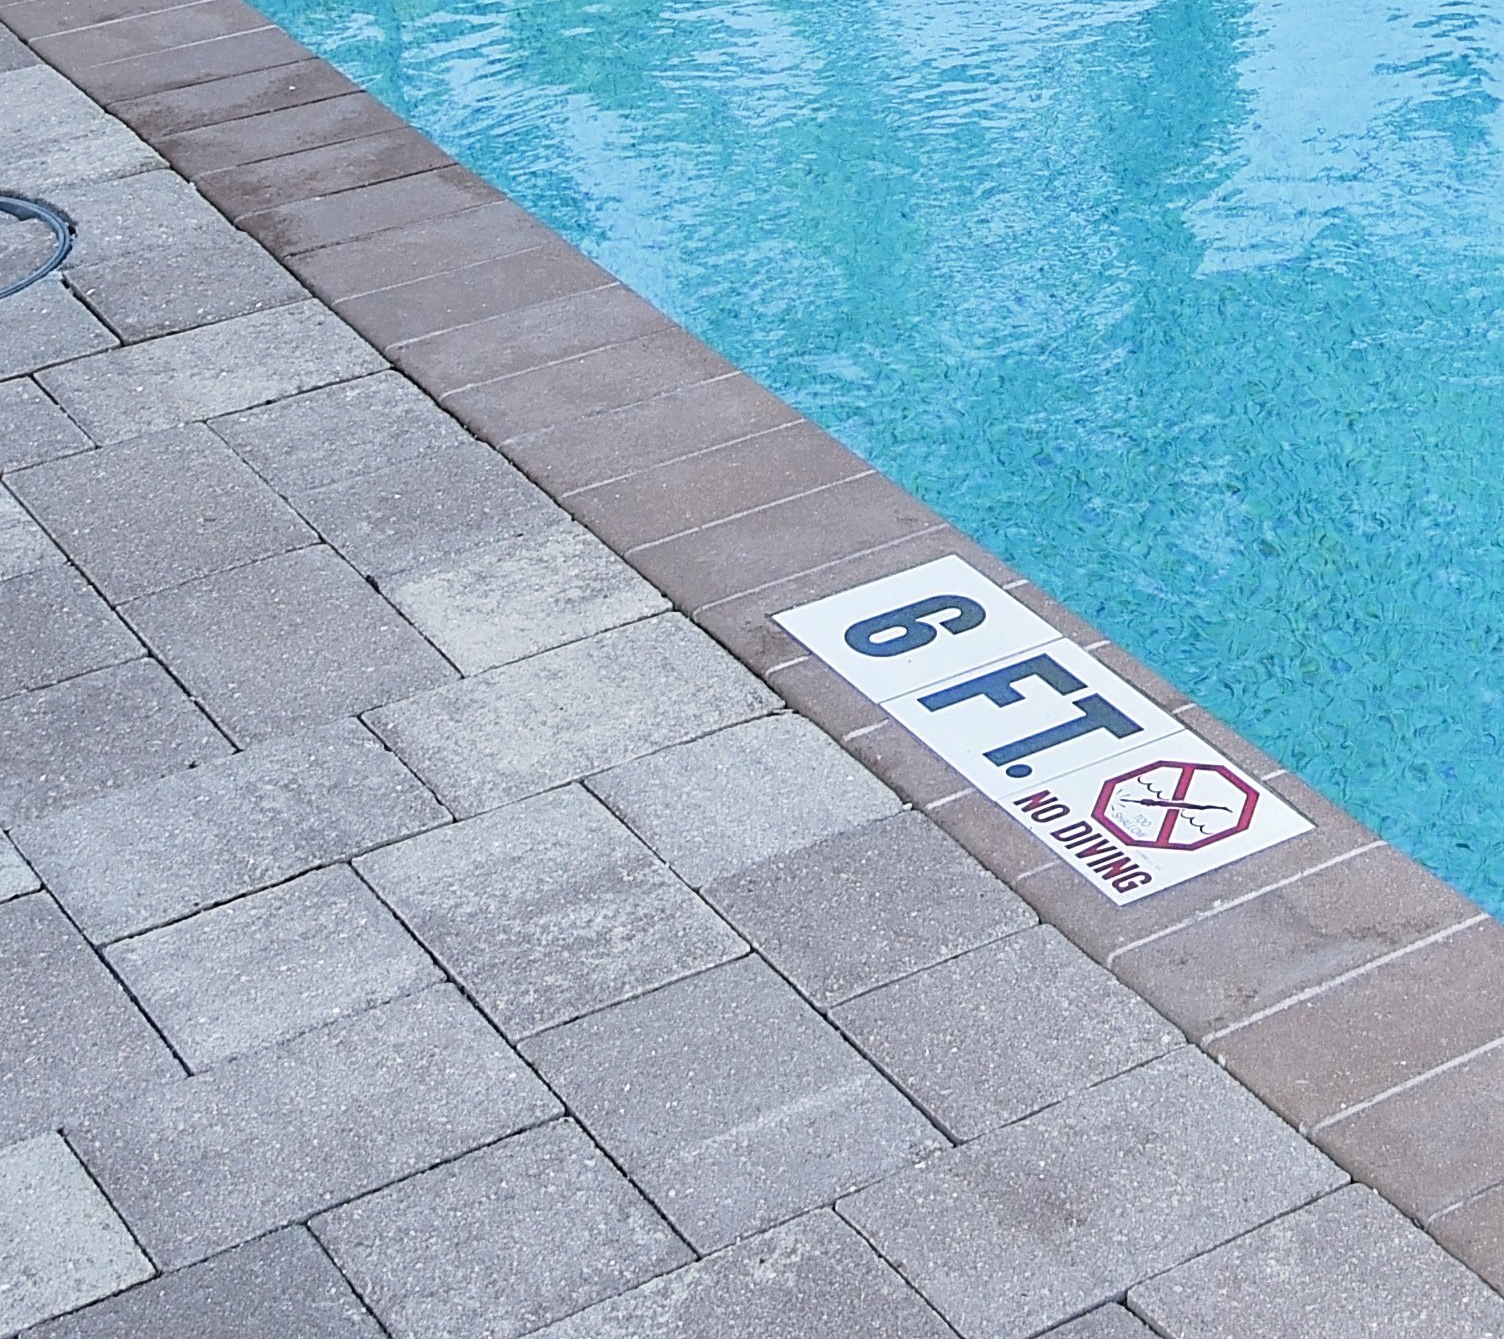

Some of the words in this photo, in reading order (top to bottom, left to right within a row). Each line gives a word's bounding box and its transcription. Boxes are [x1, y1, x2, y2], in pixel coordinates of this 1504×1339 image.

[844, 593, 987, 658] 6
[916, 652, 1145, 780] FT.
[1013, 788, 1072, 824] NO
[1049, 816, 1153, 894] DIVING
